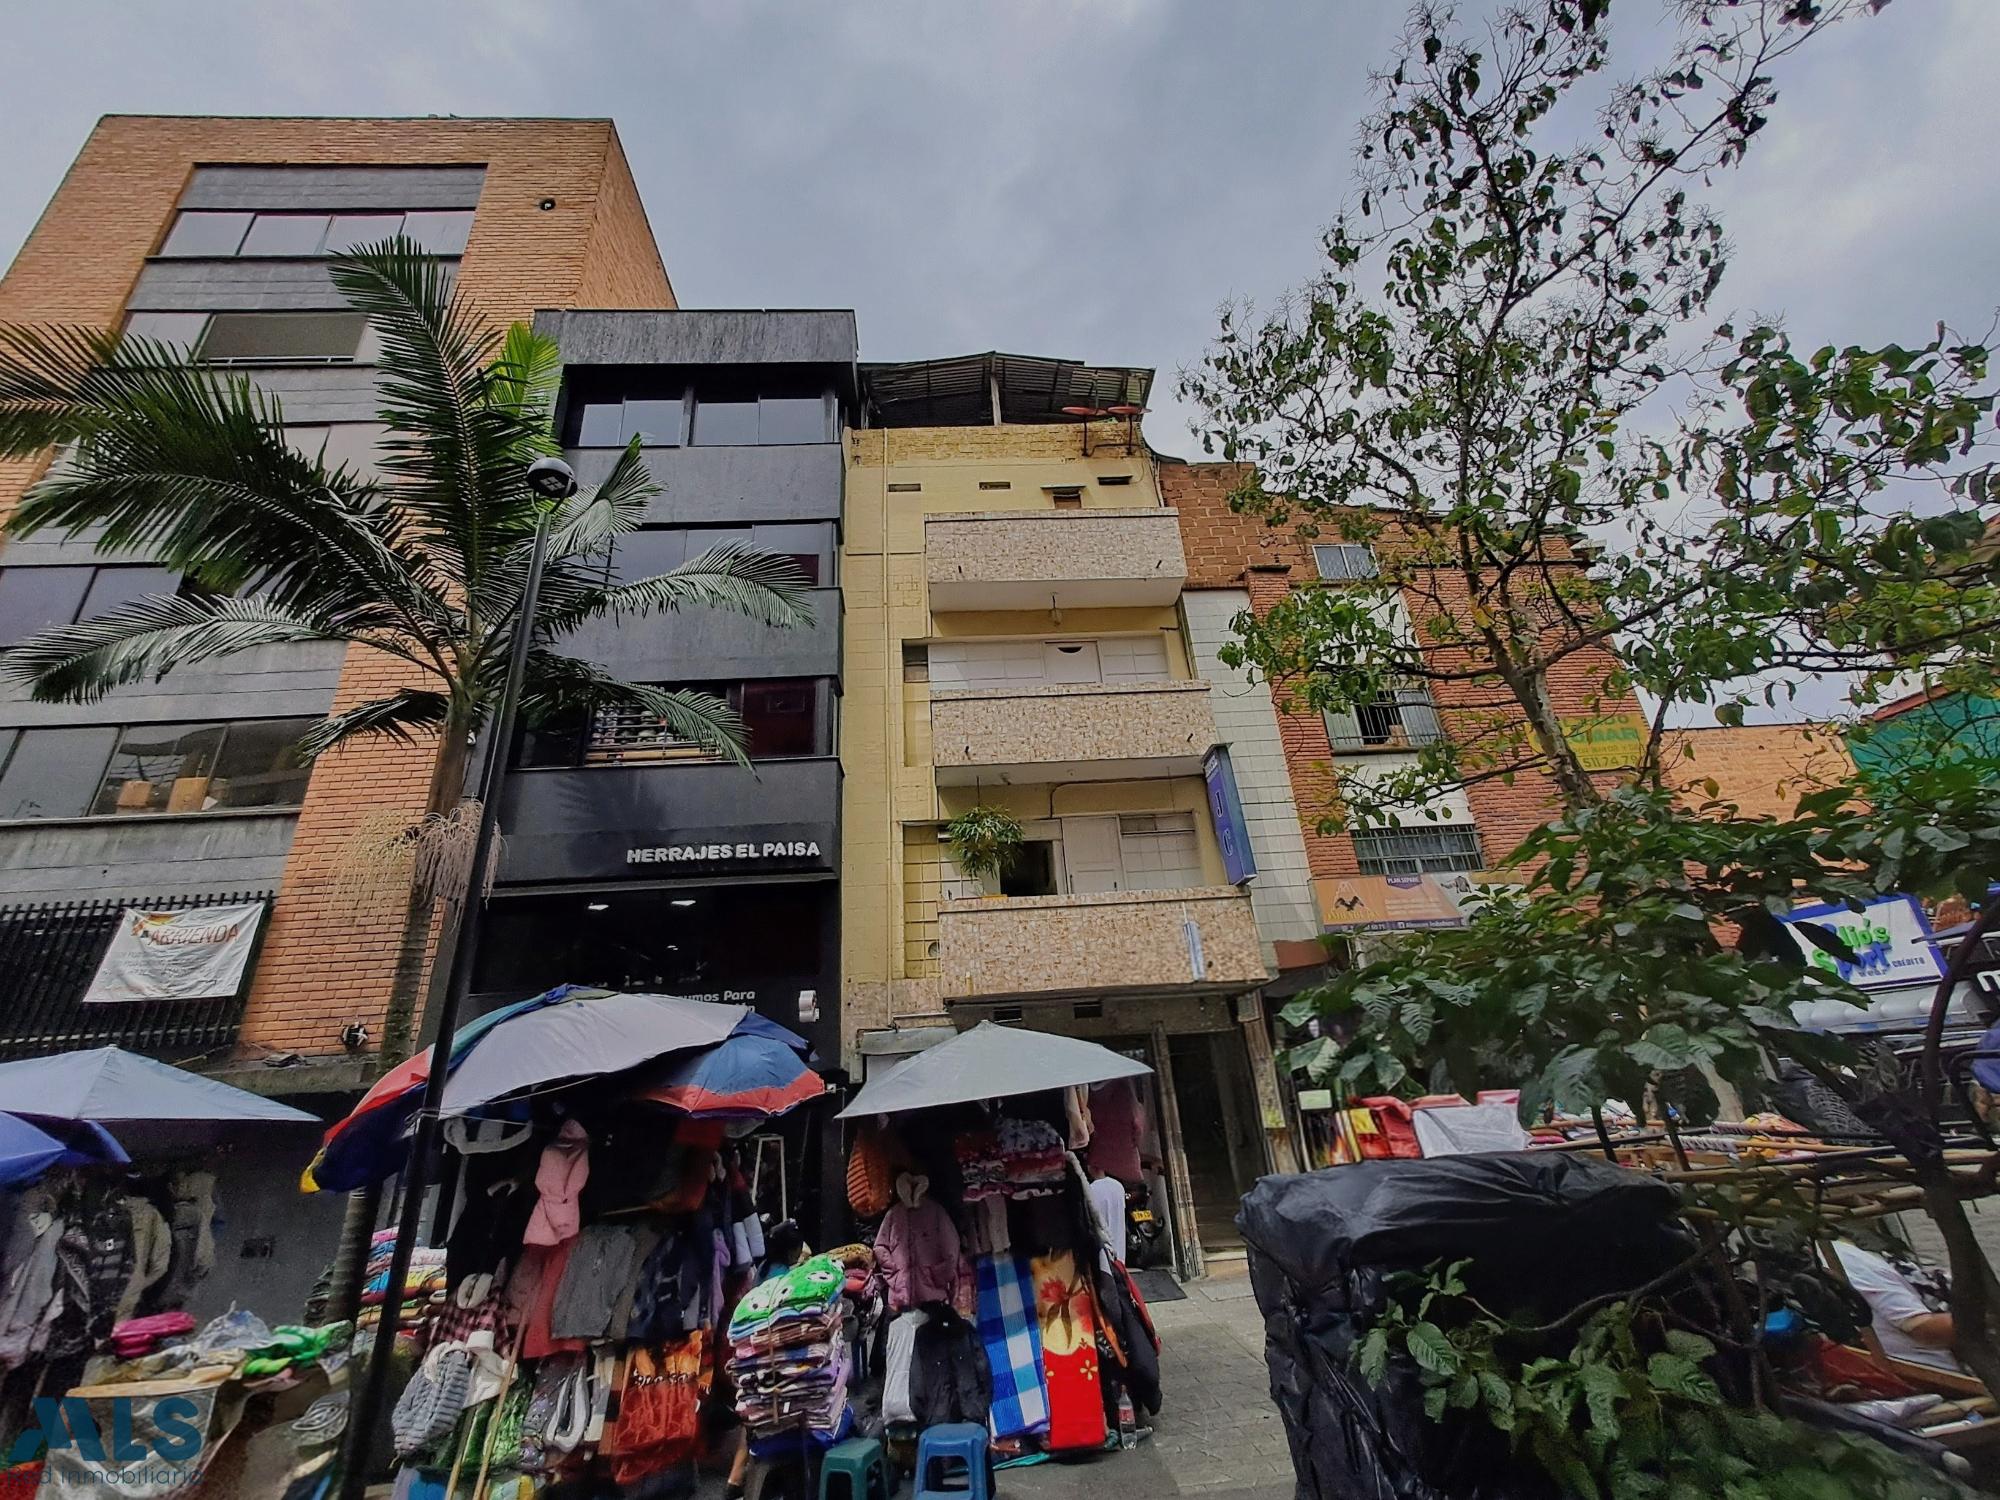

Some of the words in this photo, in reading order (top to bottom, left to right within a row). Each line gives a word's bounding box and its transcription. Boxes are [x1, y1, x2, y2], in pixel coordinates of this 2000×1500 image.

[626, 844, 733, 863] HERRAJES
[735, 843, 760, 858] EL
[763, 842, 820, 857] PAISA
[147, 923, 240, 946] ARRIENDA
[723, 990, 755, 1001] Para
